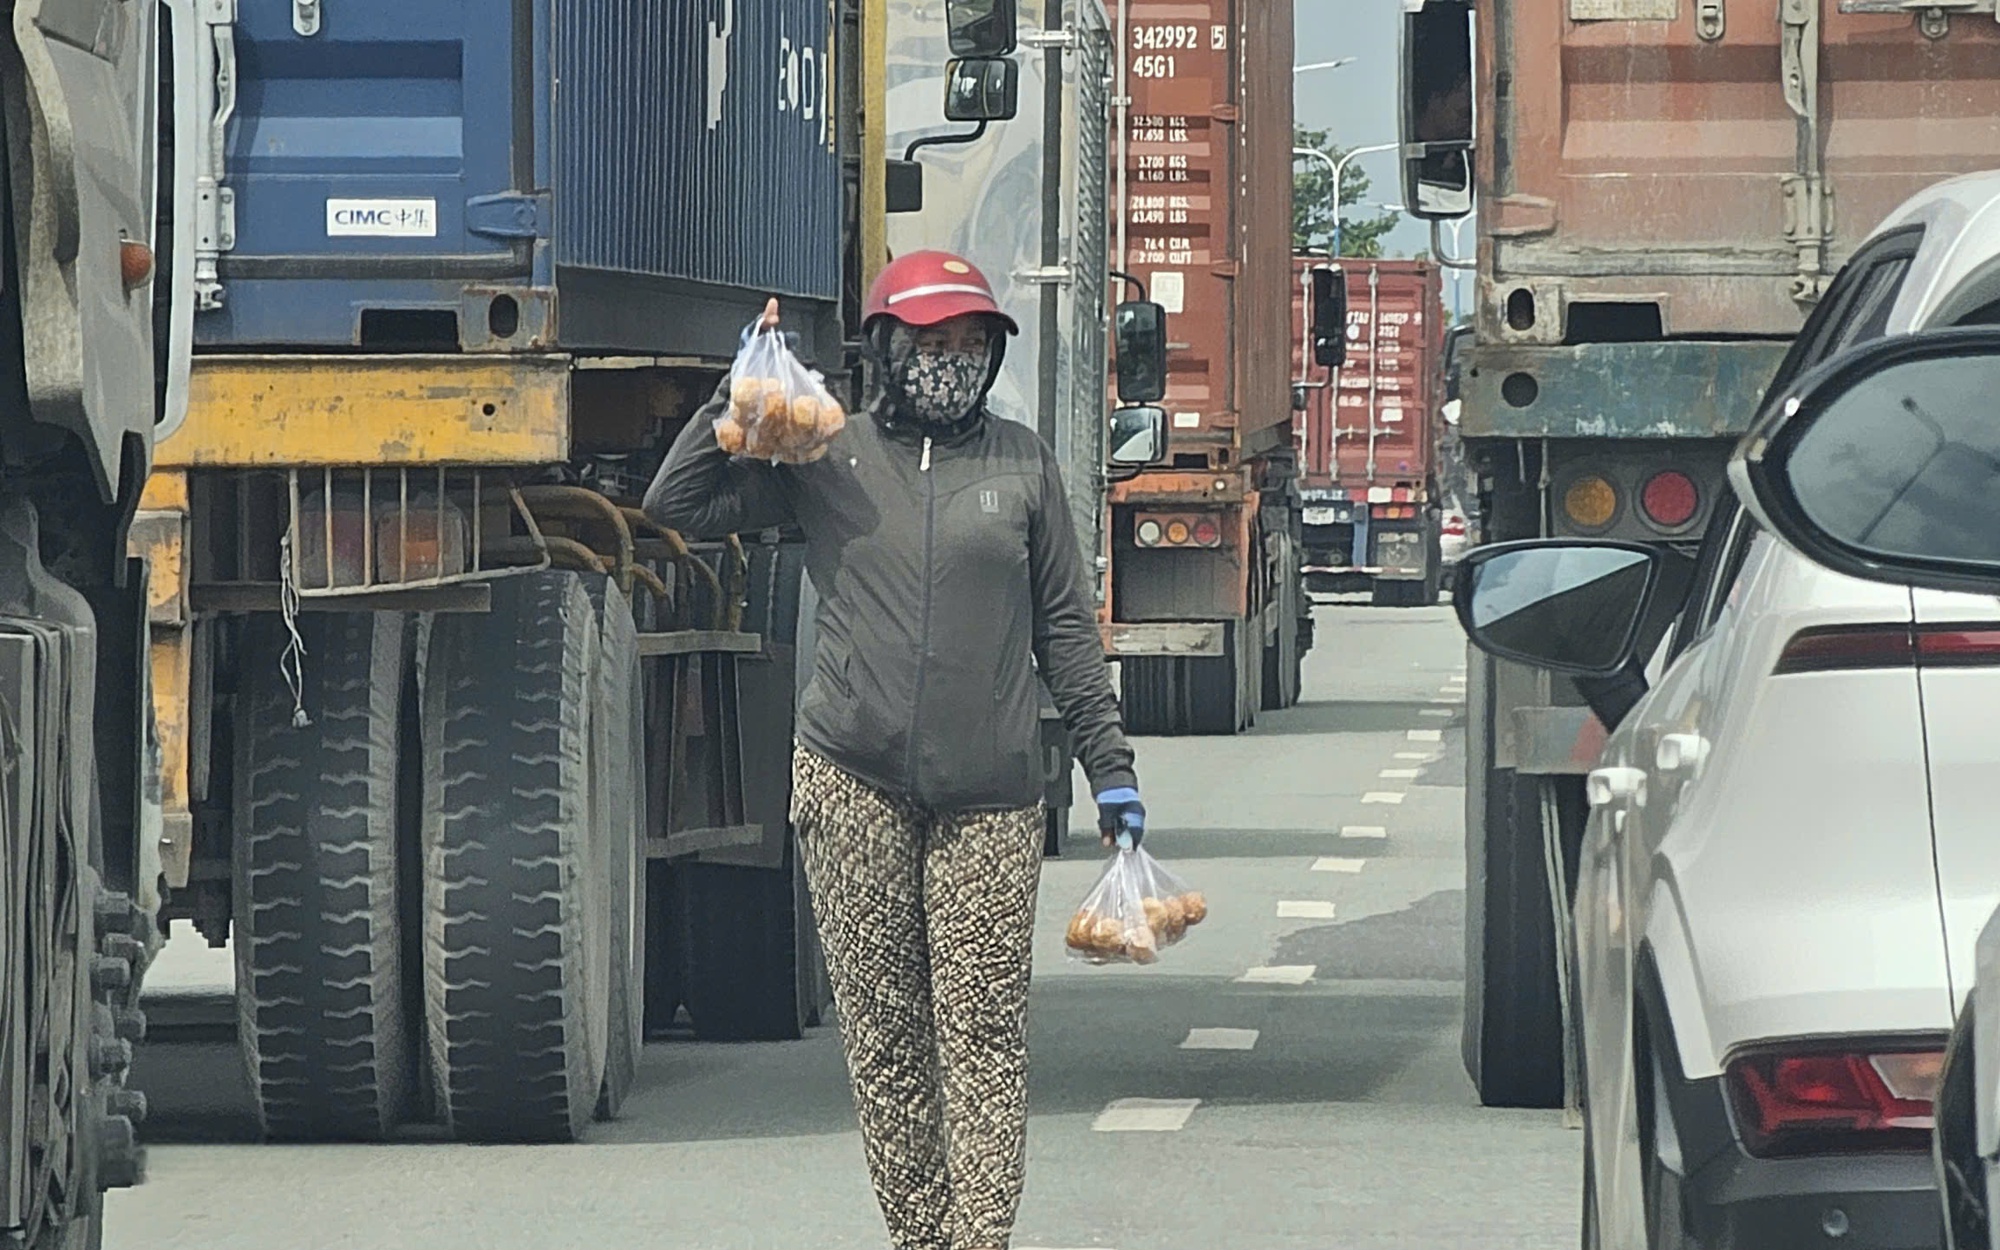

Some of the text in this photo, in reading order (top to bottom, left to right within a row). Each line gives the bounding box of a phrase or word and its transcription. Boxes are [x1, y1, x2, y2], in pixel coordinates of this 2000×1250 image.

[1133, 25, 1226, 50] 342992 5
[1133, 55, 1175, 78] 45G1
[334, 209, 392, 226] CIMC
